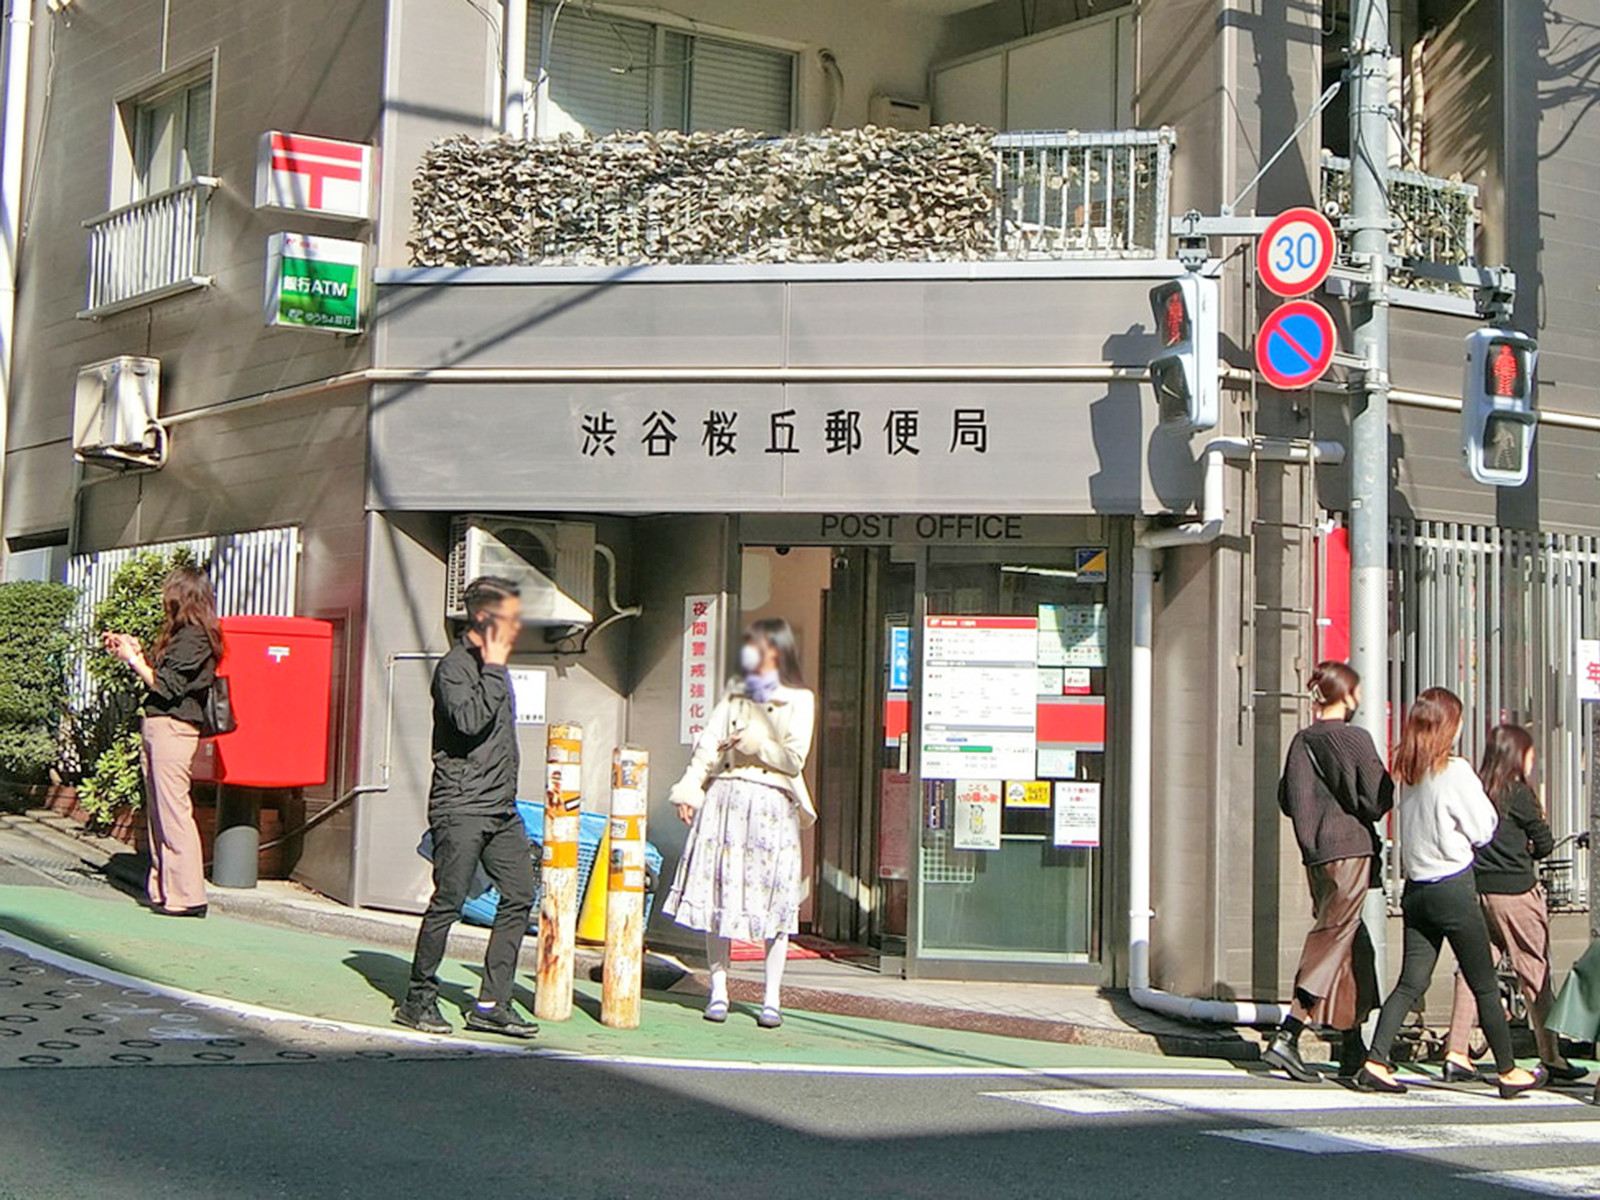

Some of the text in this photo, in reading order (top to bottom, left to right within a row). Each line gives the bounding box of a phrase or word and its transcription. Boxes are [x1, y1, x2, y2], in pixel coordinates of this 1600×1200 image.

[1275, 232, 1317, 272] 30
[283, 275, 348, 297] 銀行ATM
[580, 408, 988, 457] 渋谷桜丘郵便局
[820, 514, 1022, 539] POST OFFICE
